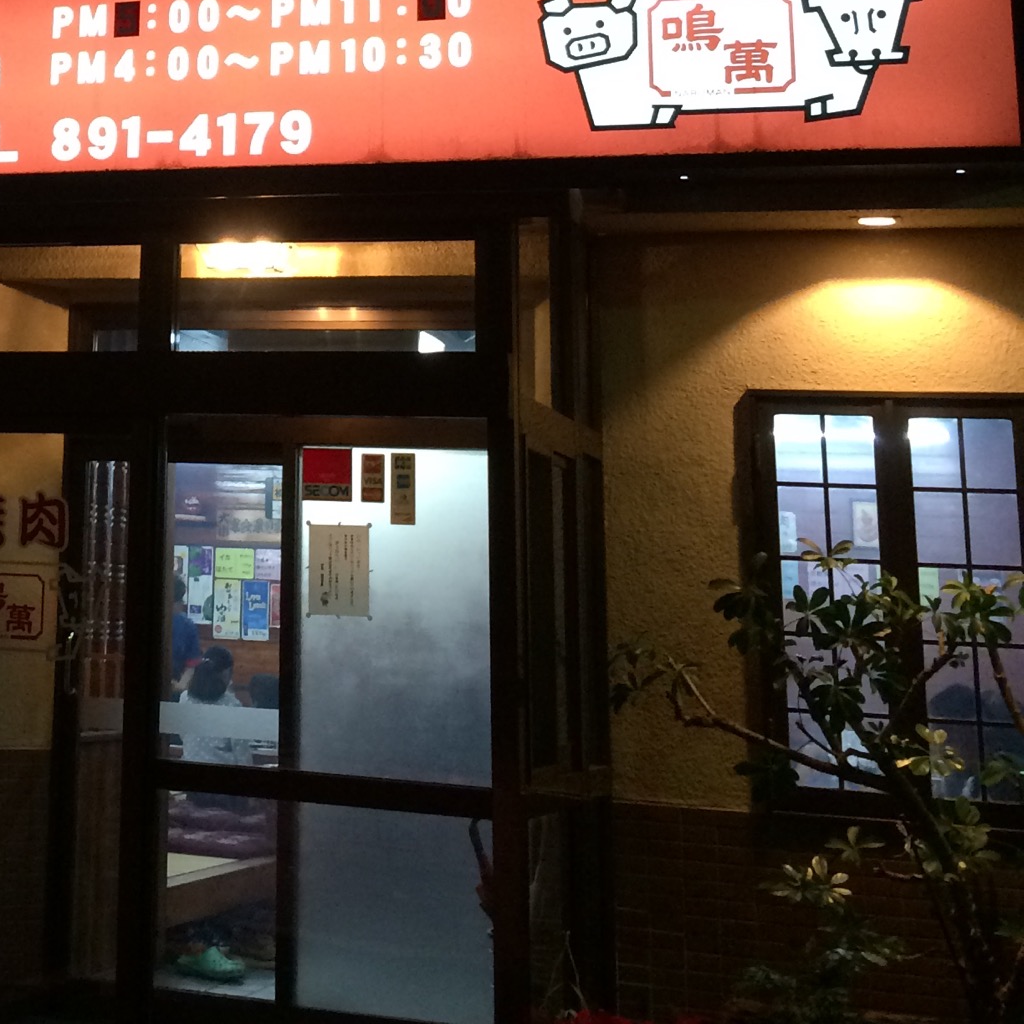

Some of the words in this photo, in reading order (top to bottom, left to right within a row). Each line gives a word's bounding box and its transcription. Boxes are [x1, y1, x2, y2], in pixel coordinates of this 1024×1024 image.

[662, 5, 776, 84] 鳴萬
[52, 110, 314, 162] 891-4179
[304, 485, 349, 496] SECOM
